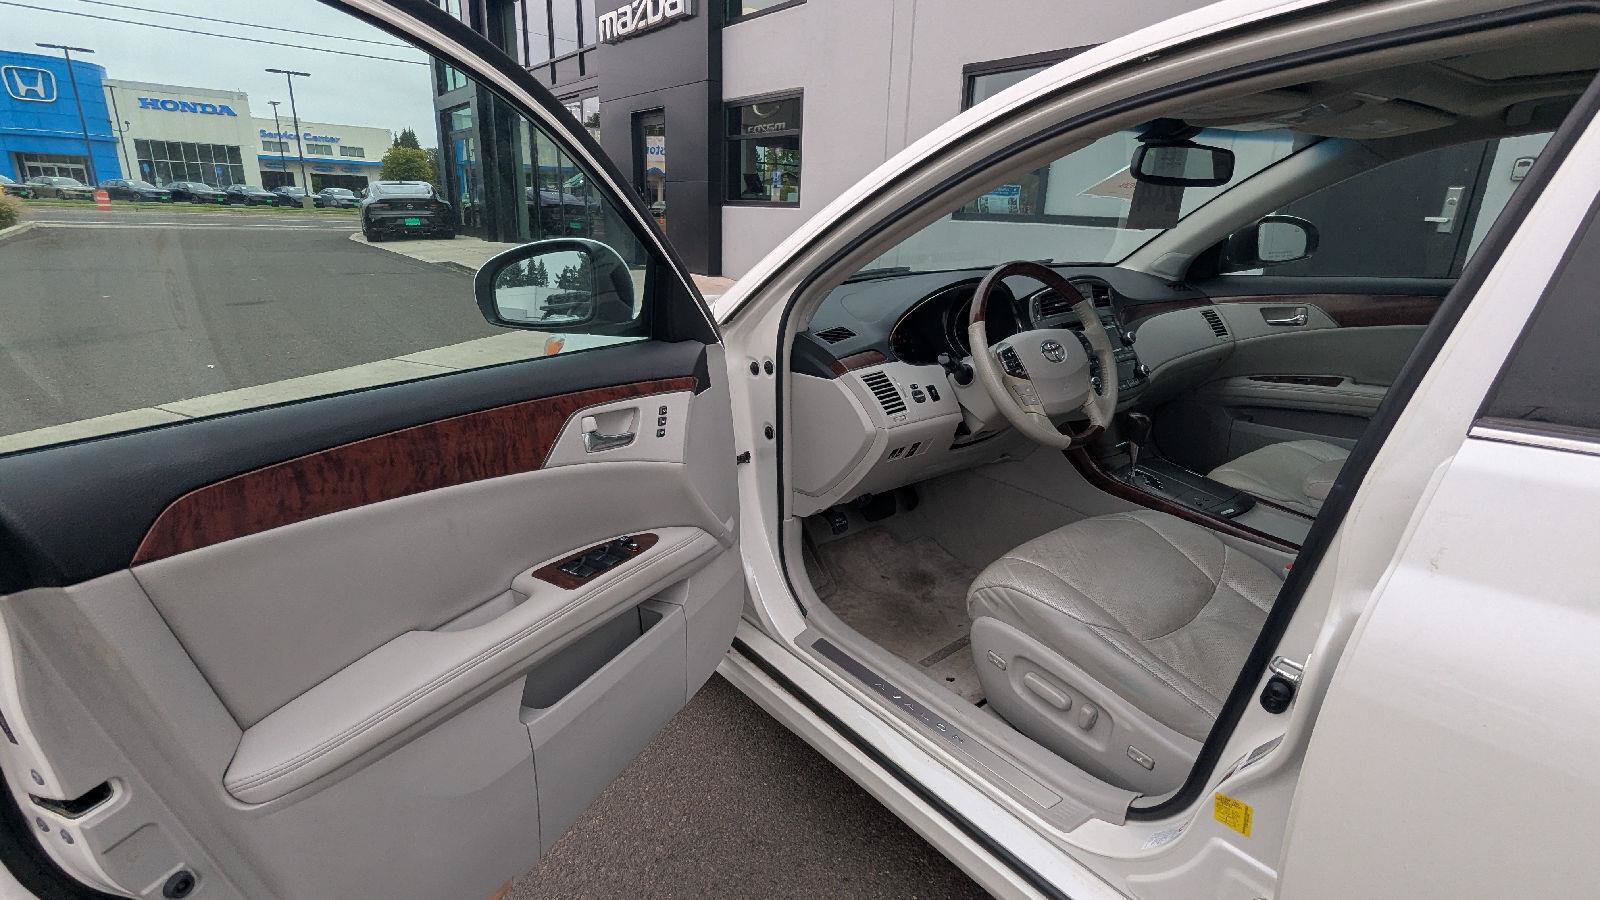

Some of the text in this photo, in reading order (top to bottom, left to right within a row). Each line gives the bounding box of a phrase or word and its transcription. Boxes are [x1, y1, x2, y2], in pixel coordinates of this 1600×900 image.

[599, 0, 685, 43] mazda
[138, 97, 237, 116] HONDA
[303, 133, 340, 143] Center
